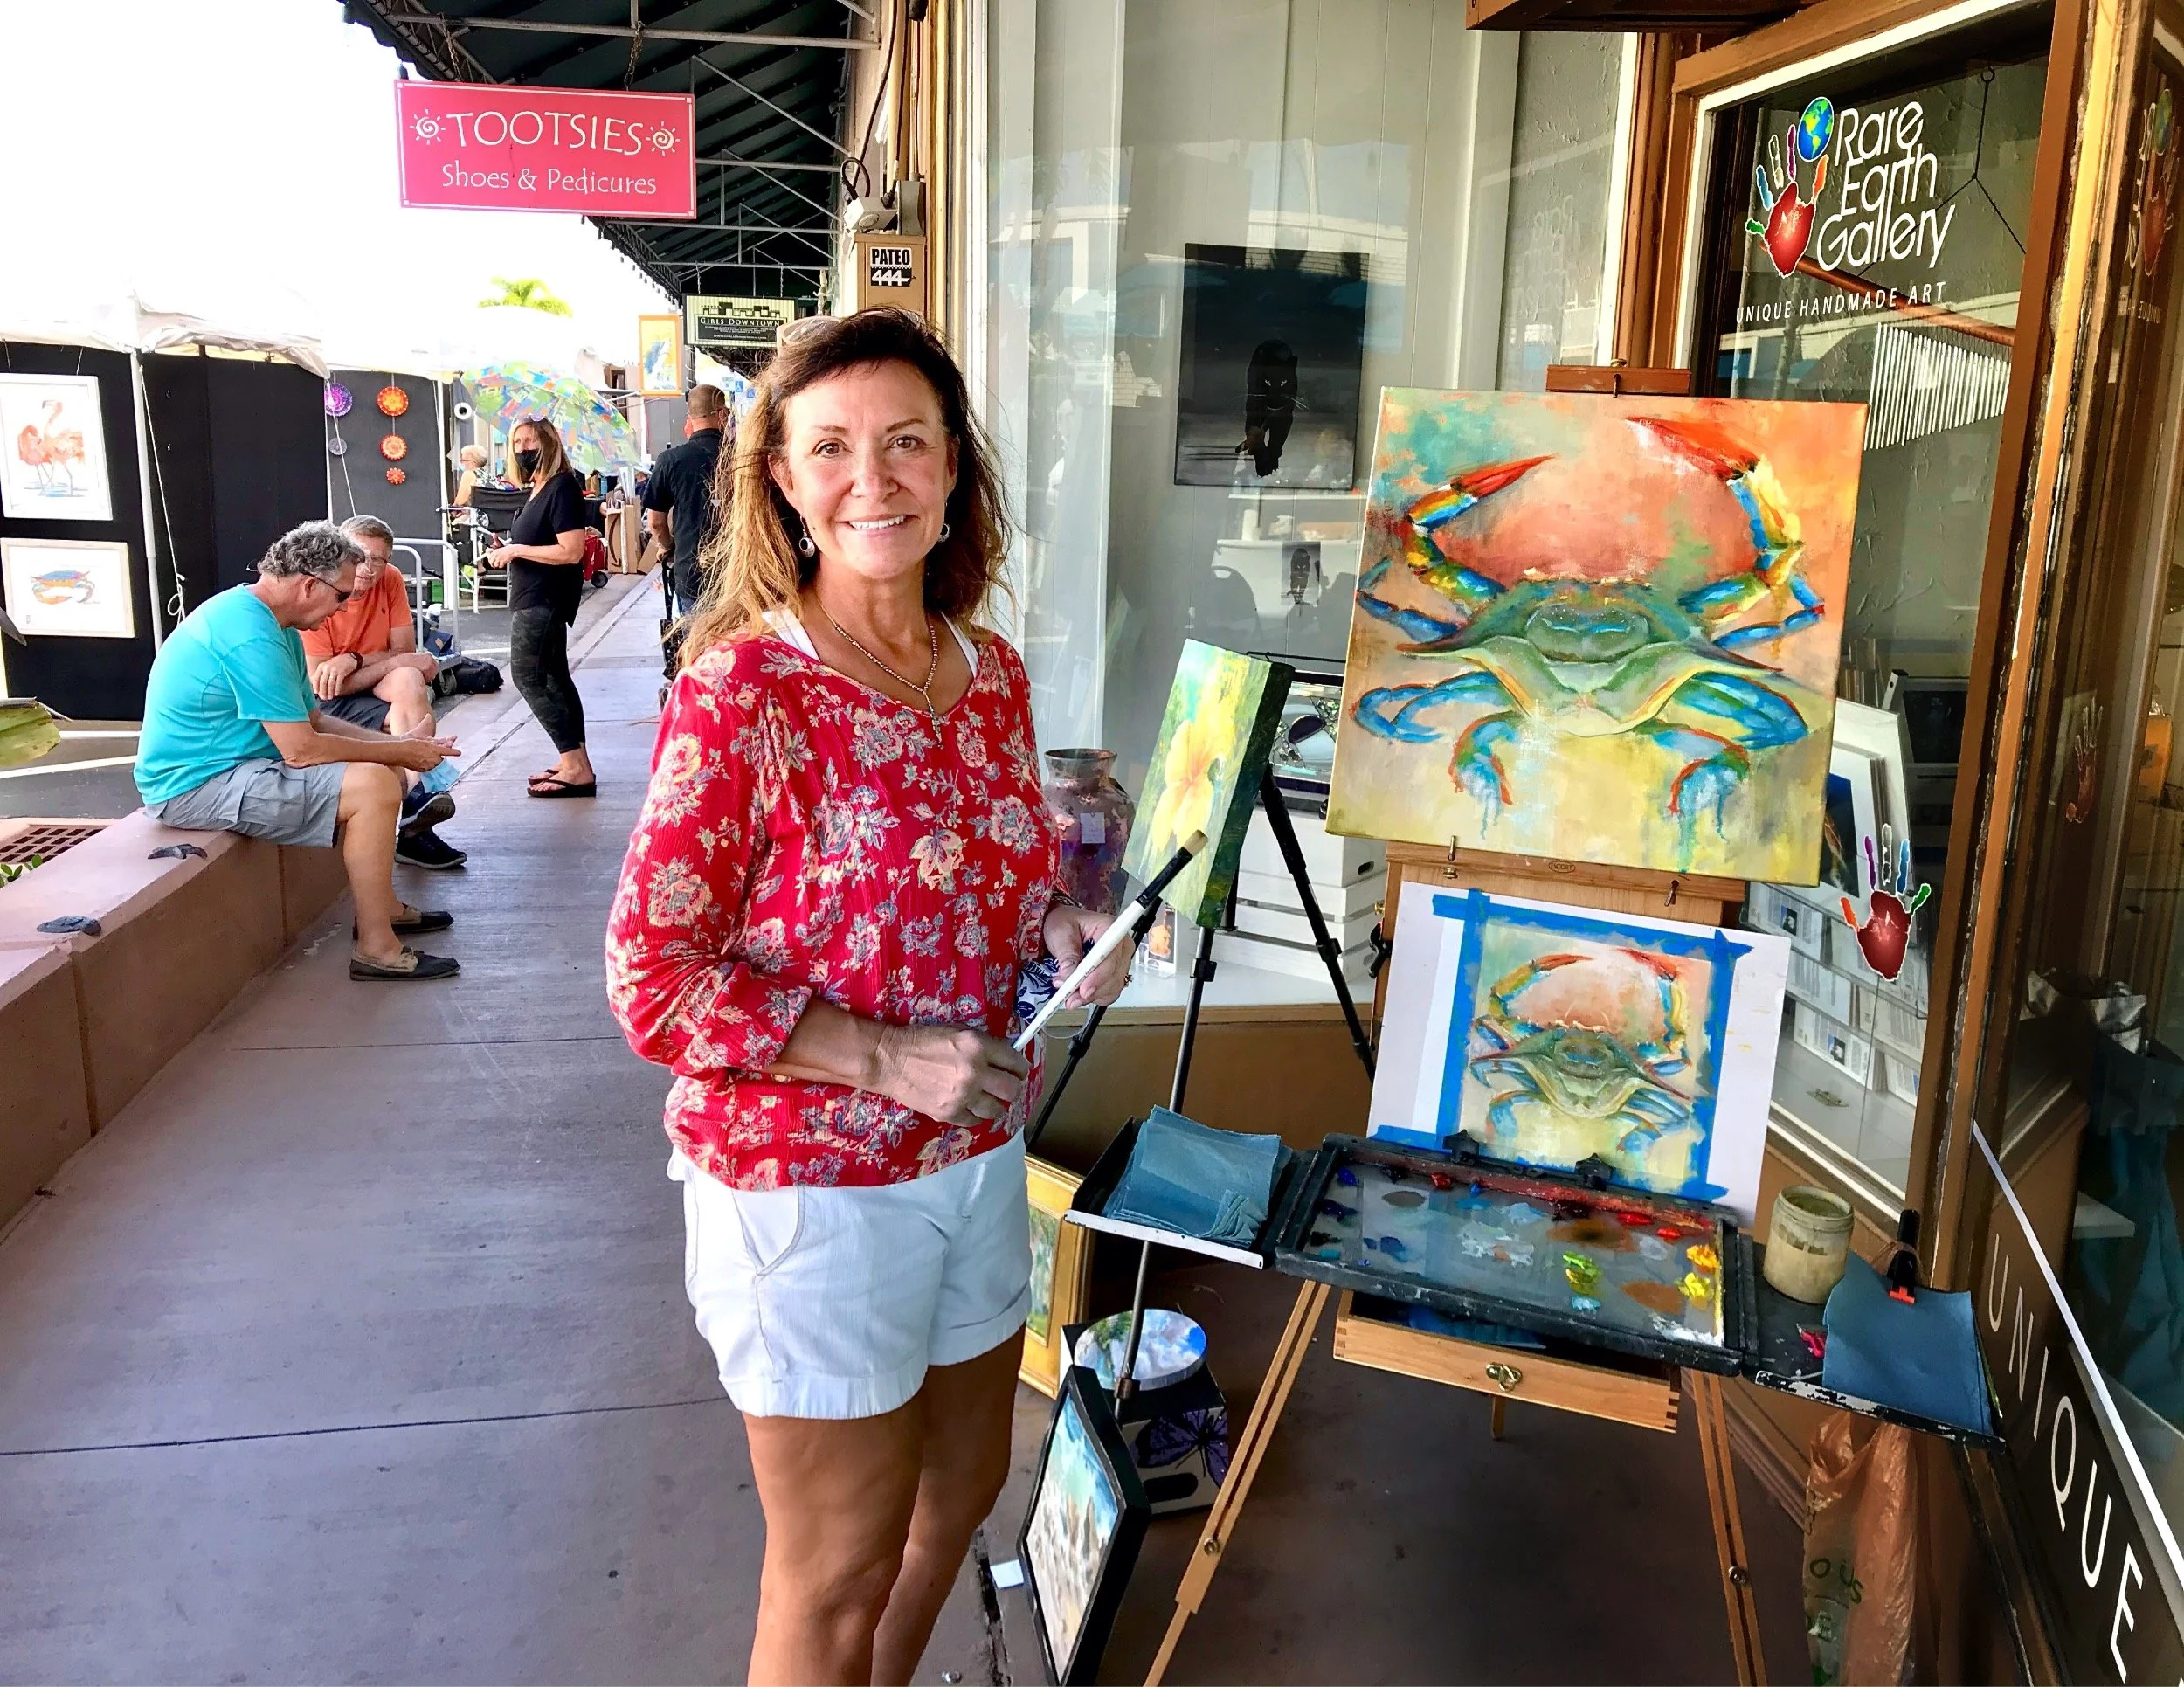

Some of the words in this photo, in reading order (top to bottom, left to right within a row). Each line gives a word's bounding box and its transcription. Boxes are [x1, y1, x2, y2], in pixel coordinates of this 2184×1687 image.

[446, 111, 643, 156] TOOTSIES
[1835, 101, 1923, 166] Rare
[442, 160, 509, 189] Shoes
[517, 169, 537, 192] &
[548, 168, 657, 195] Pedicures
[1840, 143, 1938, 217] Earth
[872, 248, 910, 265] PATEO
[1817, 204, 1955, 271] Gallery
[872, 269, 910, 287] 444
[729, 318, 780, 327] DOWNTOWN
[1736, 300, 1792, 324] UNIQUE
[1800, 287, 1898, 317] HANDMADE
[1908, 281, 1946, 305] ART
[1988, 1233, 2143, 1684] UNIQUE
